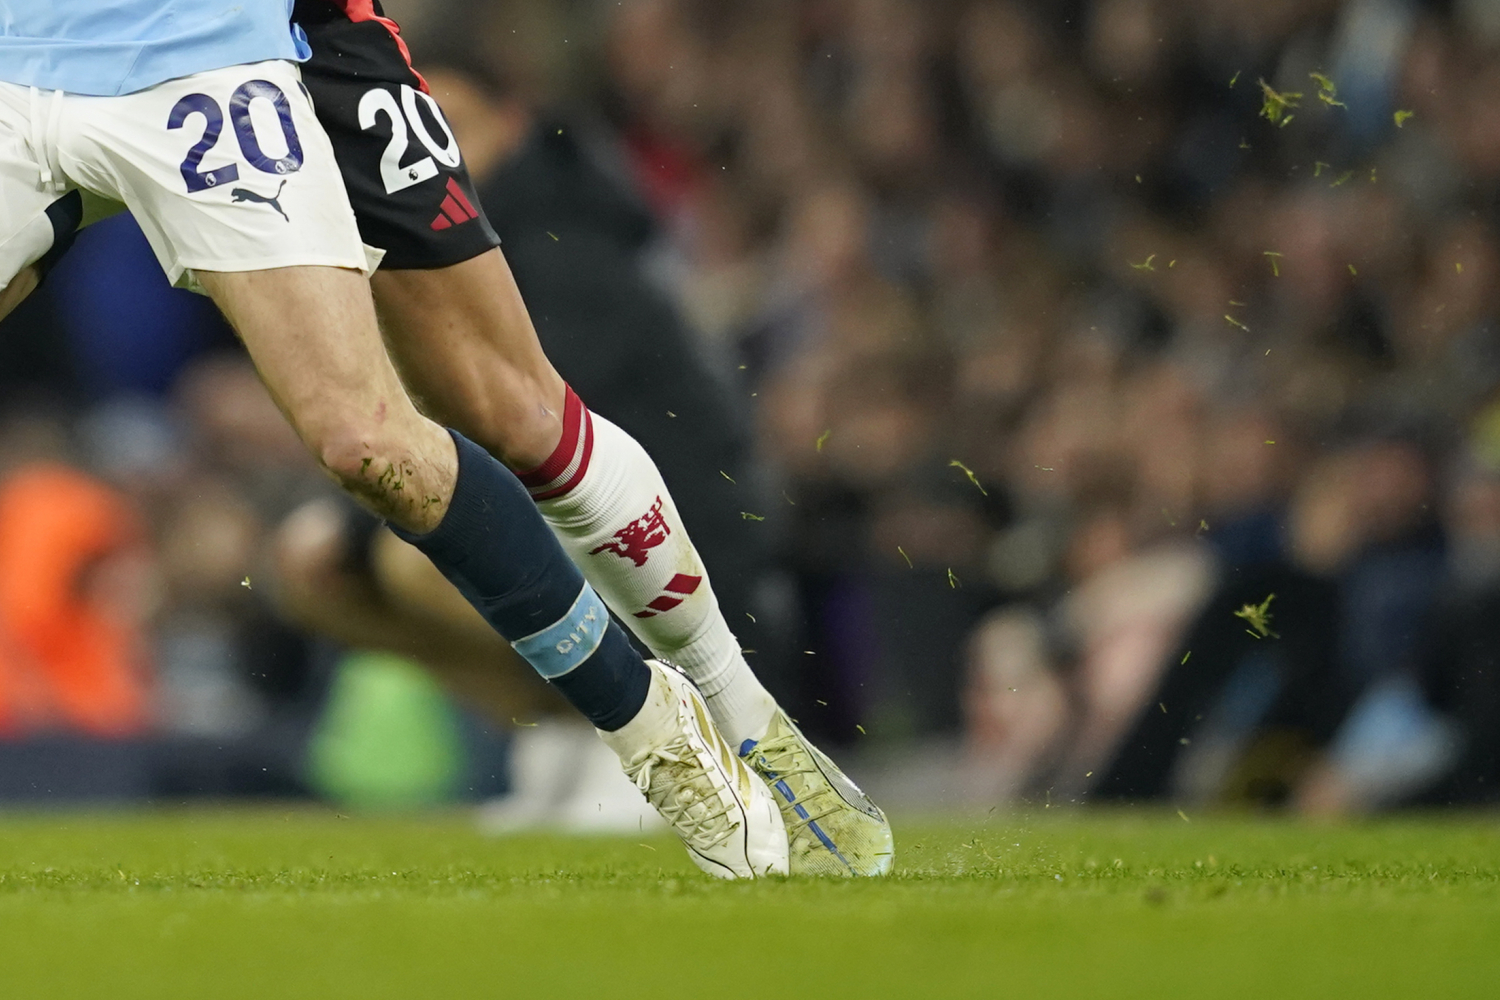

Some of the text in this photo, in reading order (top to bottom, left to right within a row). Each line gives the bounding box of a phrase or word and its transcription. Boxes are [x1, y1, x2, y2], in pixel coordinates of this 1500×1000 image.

[166, 79, 304, 193] 20
[358, 83, 461, 195] 20
[556, 606, 597, 654] CITY
